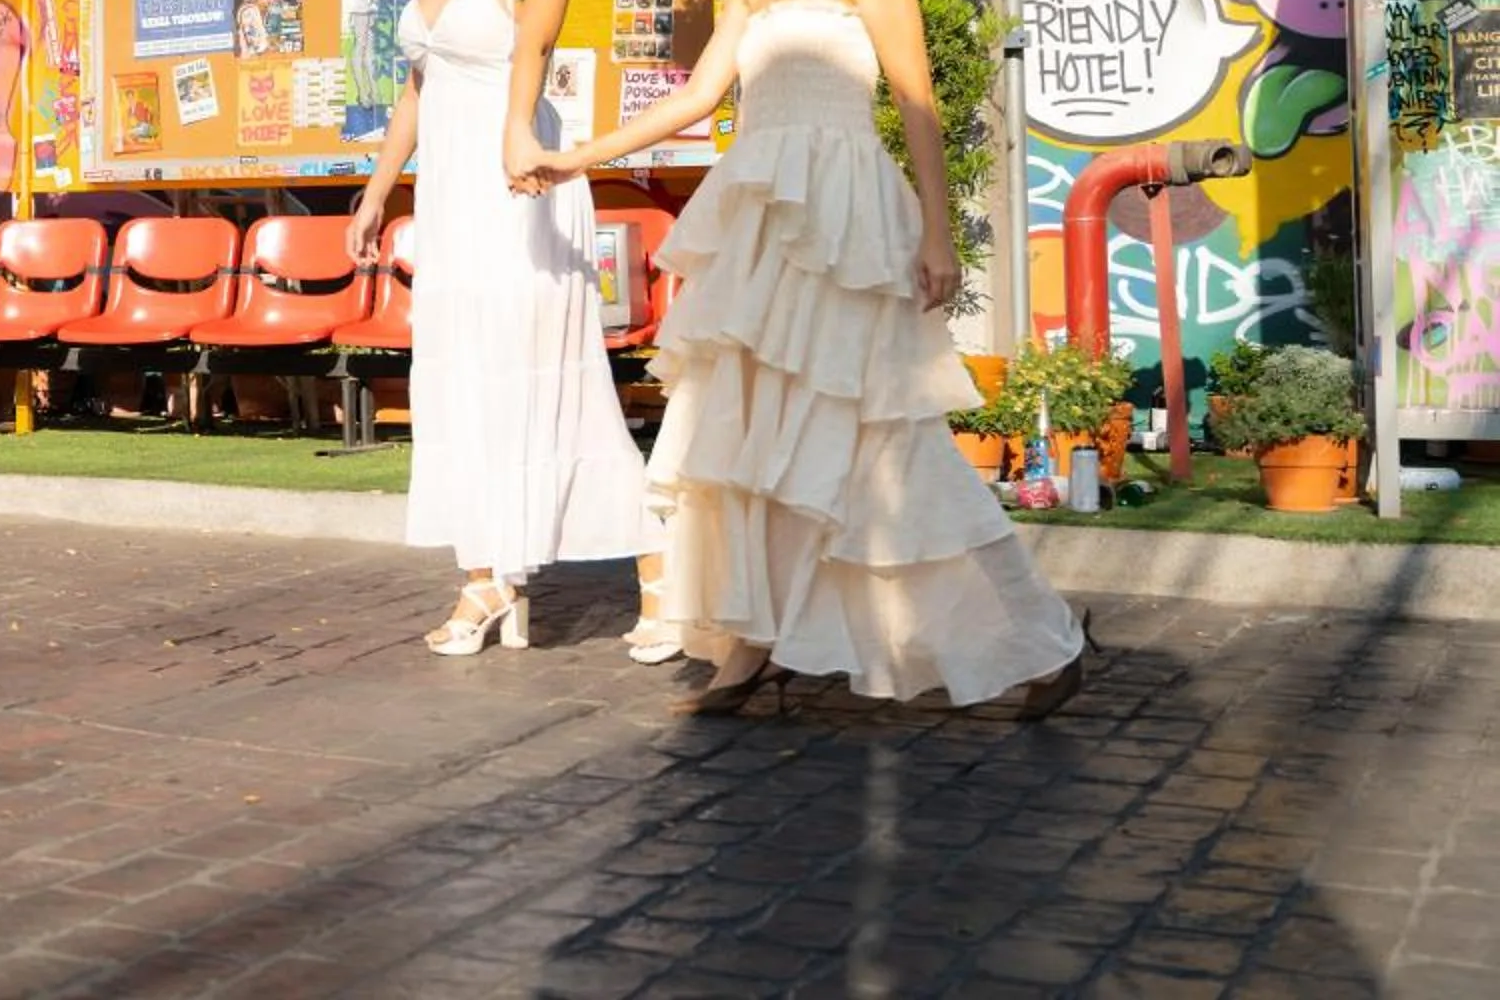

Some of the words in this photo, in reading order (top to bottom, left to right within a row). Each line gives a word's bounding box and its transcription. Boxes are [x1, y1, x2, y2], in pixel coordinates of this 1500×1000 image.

[625, 70, 660, 84] LOVE
[663, 72, 677, 84] IS
[242, 101, 290, 123] LOVE
[242, 124, 291, 143] THIEF
